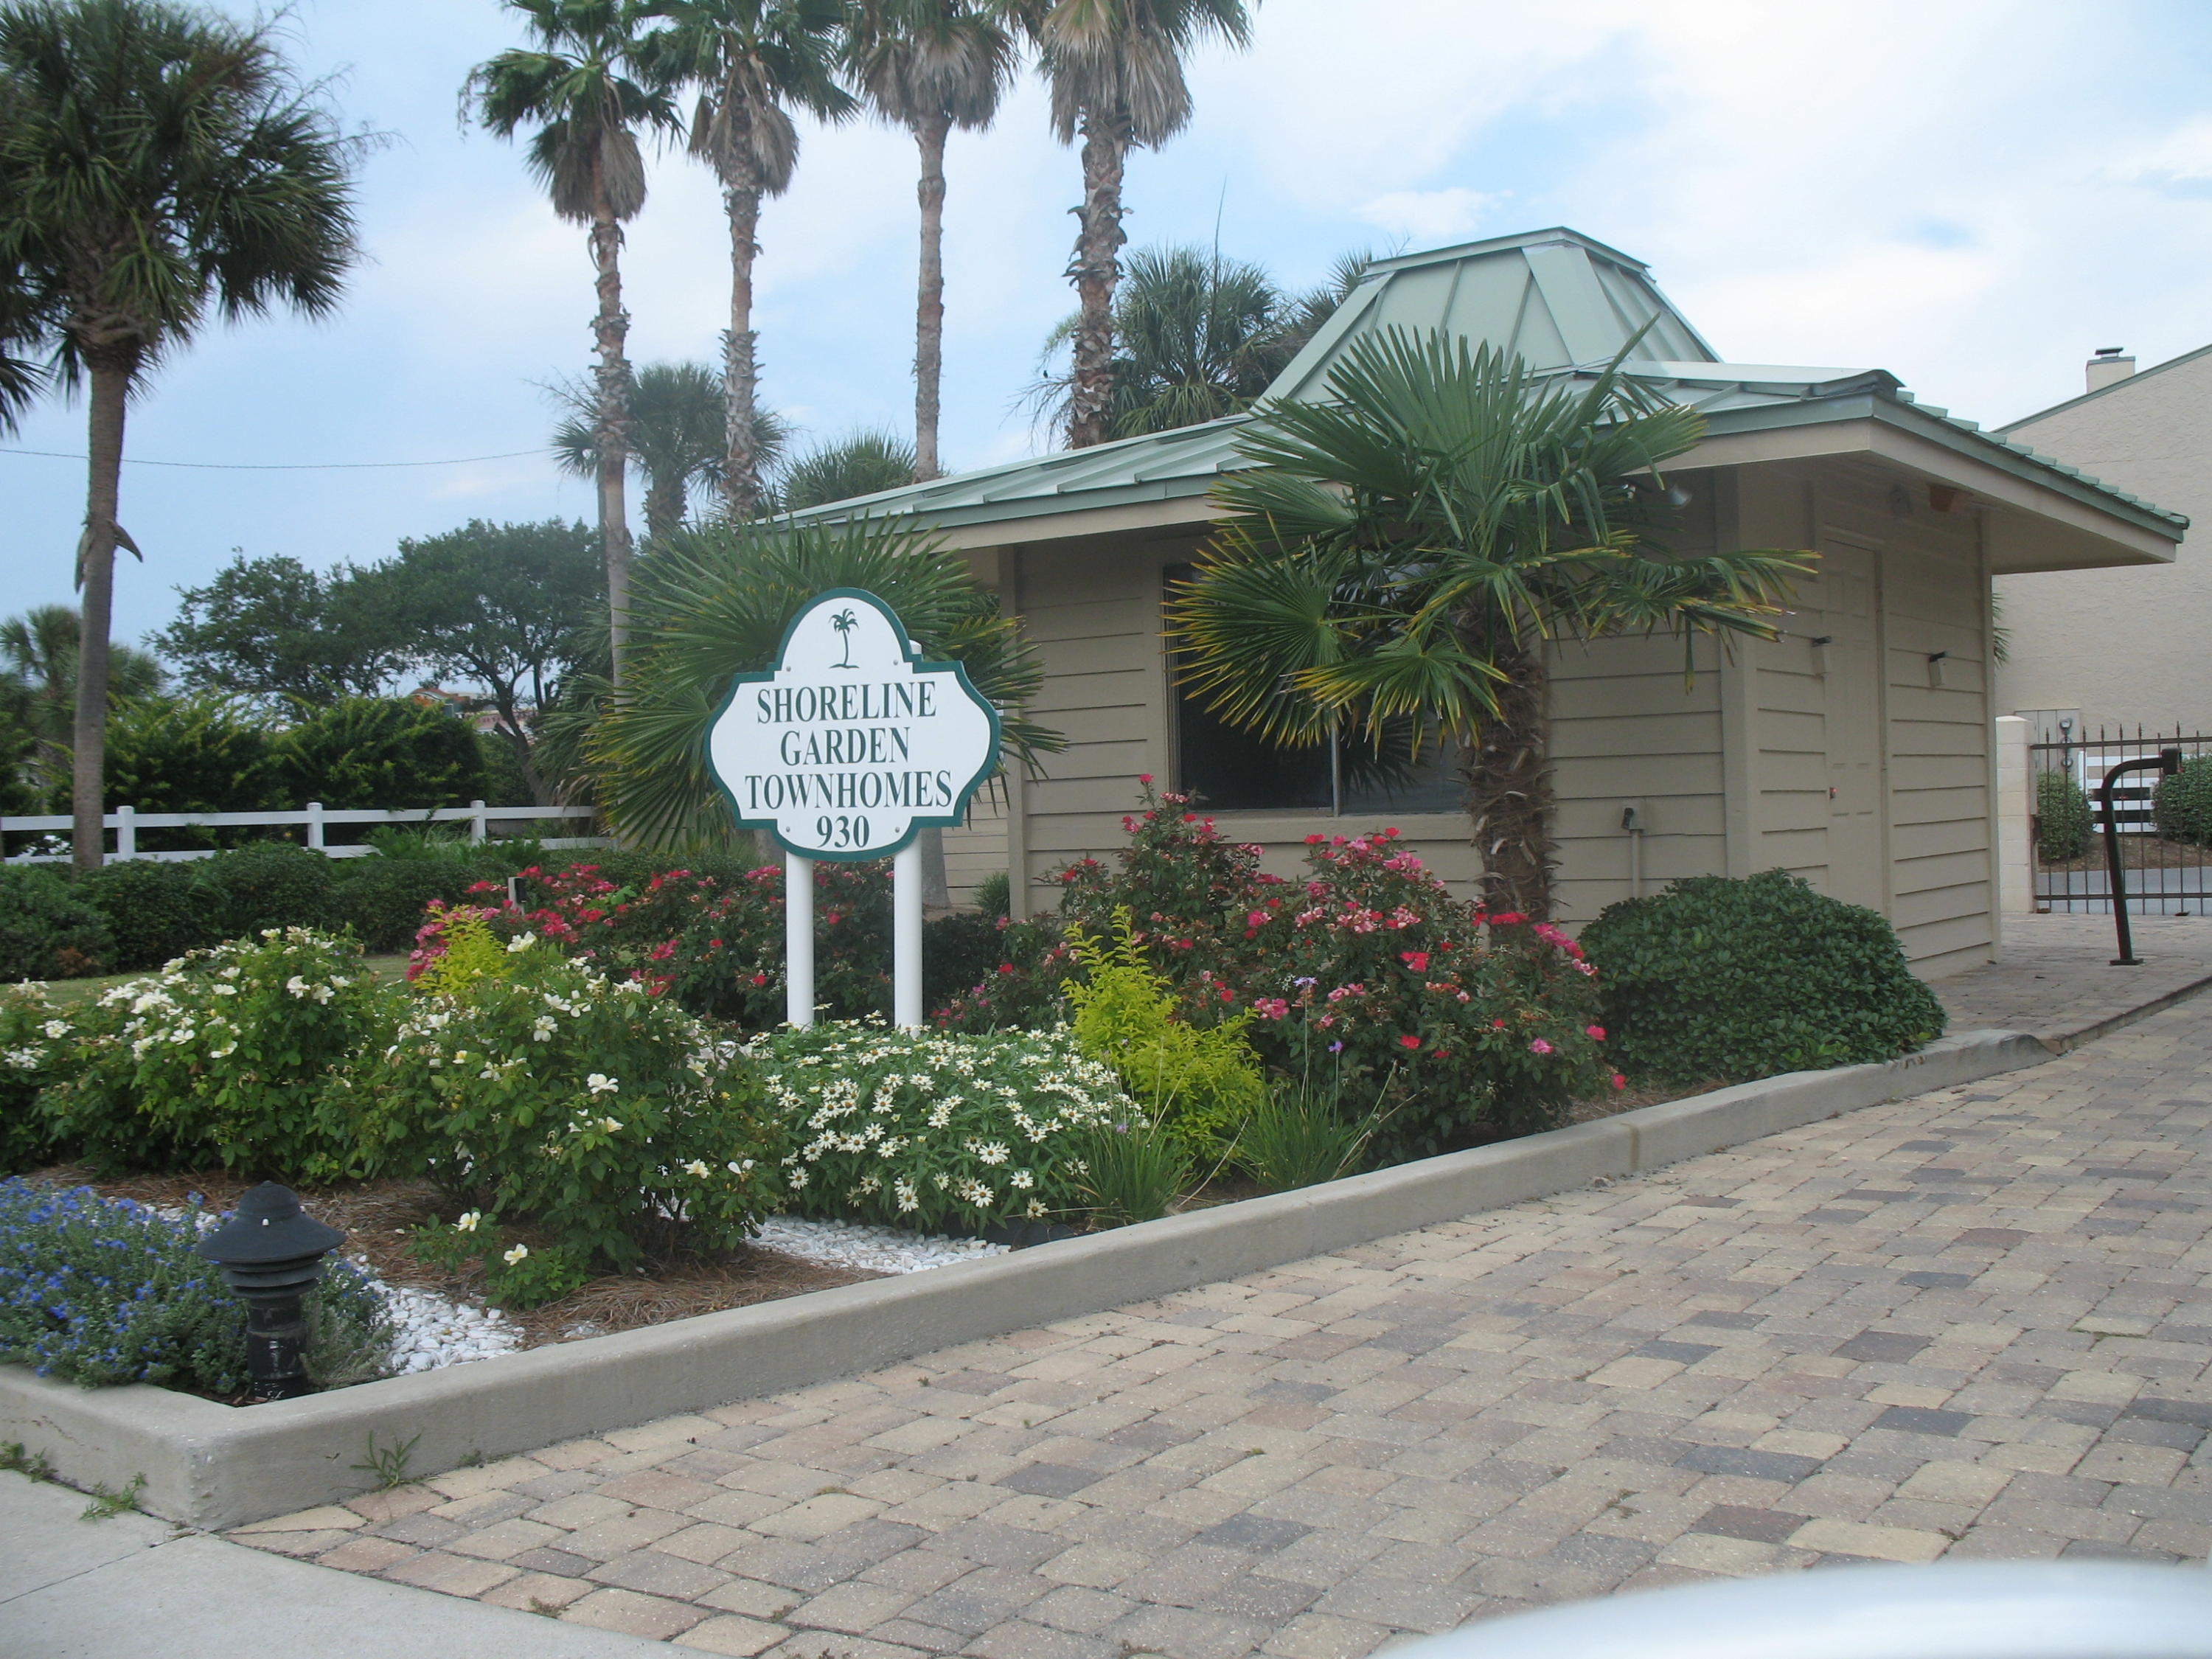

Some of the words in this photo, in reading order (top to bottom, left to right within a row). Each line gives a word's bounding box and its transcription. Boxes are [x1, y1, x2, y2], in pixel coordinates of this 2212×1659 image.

[757, 681, 936, 724] SHORELINE
[780, 726, 911, 767] GARDEN
[745, 770, 953, 810] TOWNHOMES
[816, 815, 870, 849] 930
